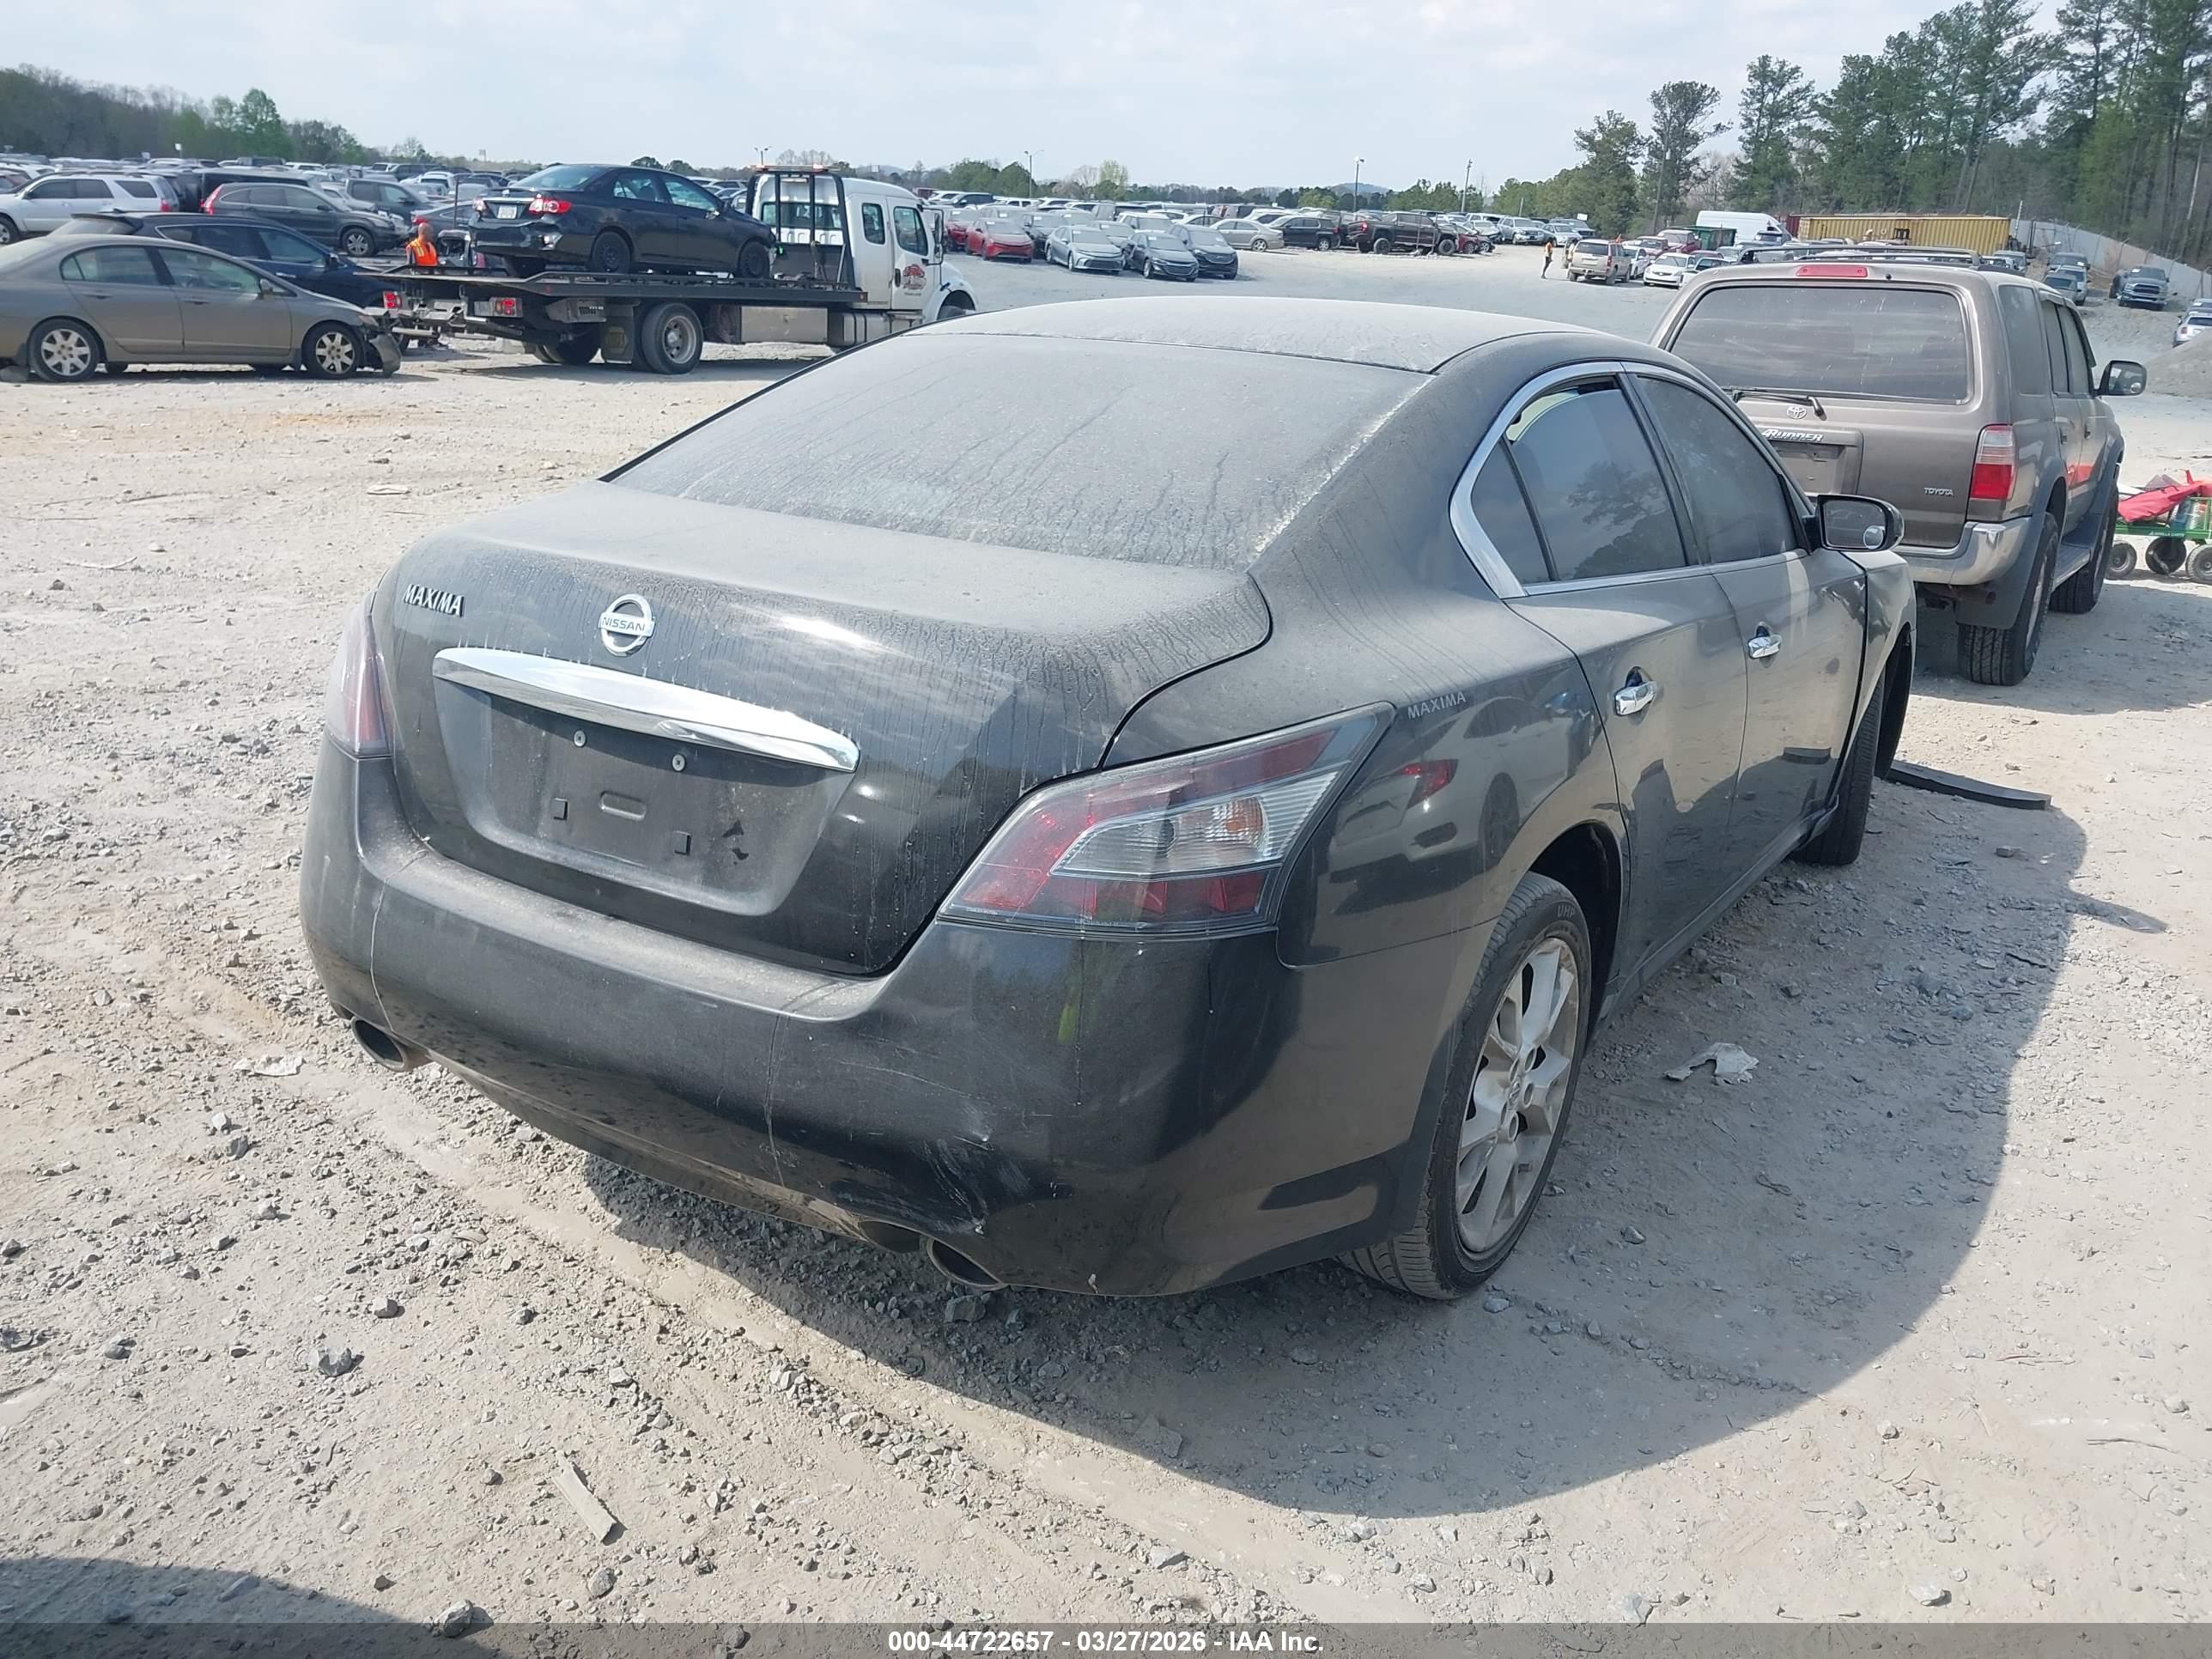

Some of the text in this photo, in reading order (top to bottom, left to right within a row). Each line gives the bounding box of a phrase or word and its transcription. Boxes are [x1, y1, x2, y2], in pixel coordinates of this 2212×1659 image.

[1923, 487, 1954, 496] TOYOTA
[402, 584, 465, 618] MAXIMA
[601, 617, 646, 632] NISSAN
[1408, 691, 1467, 720] MAXIMA
